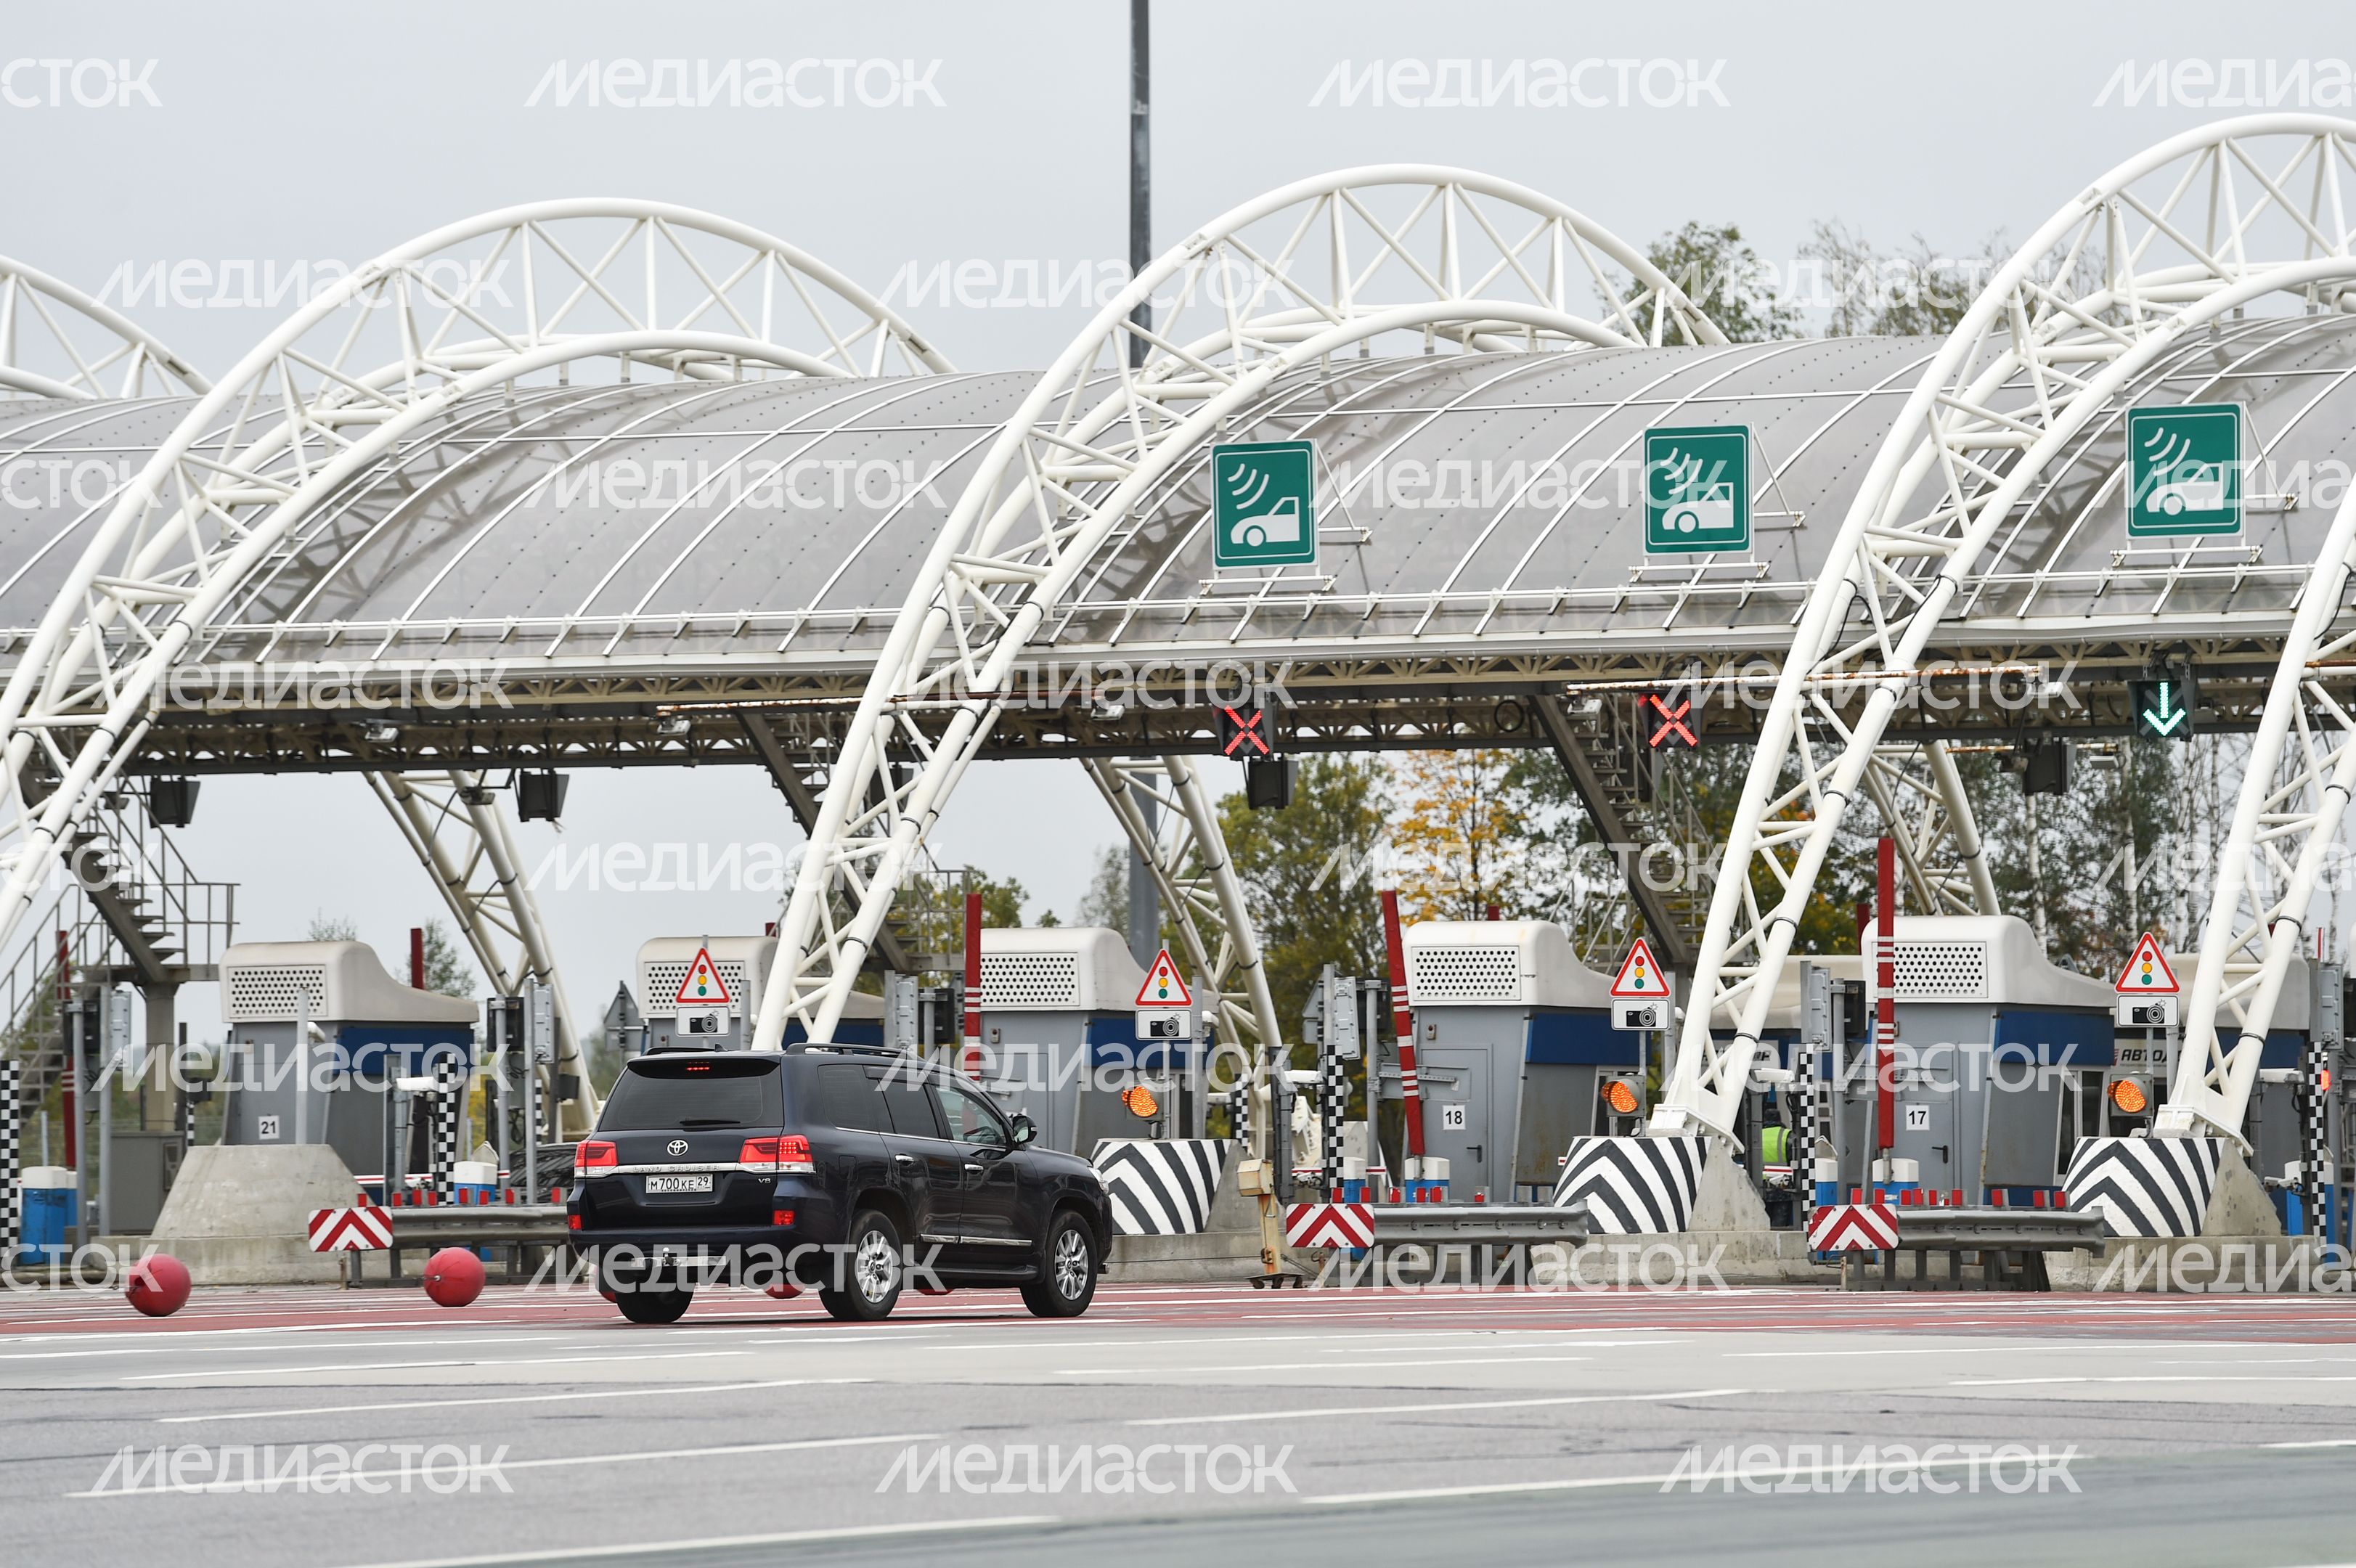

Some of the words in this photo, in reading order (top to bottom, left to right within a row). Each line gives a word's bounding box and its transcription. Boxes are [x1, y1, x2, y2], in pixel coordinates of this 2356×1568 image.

[1446, 1110, 1463, 1124] 18
[1909, 1110, 1926, 1124] 17
[261, 1121, 276, 1134] 21
[668, 1163, 721, 1172] CRUISER
[698, 1176, 709, 1186] 29
